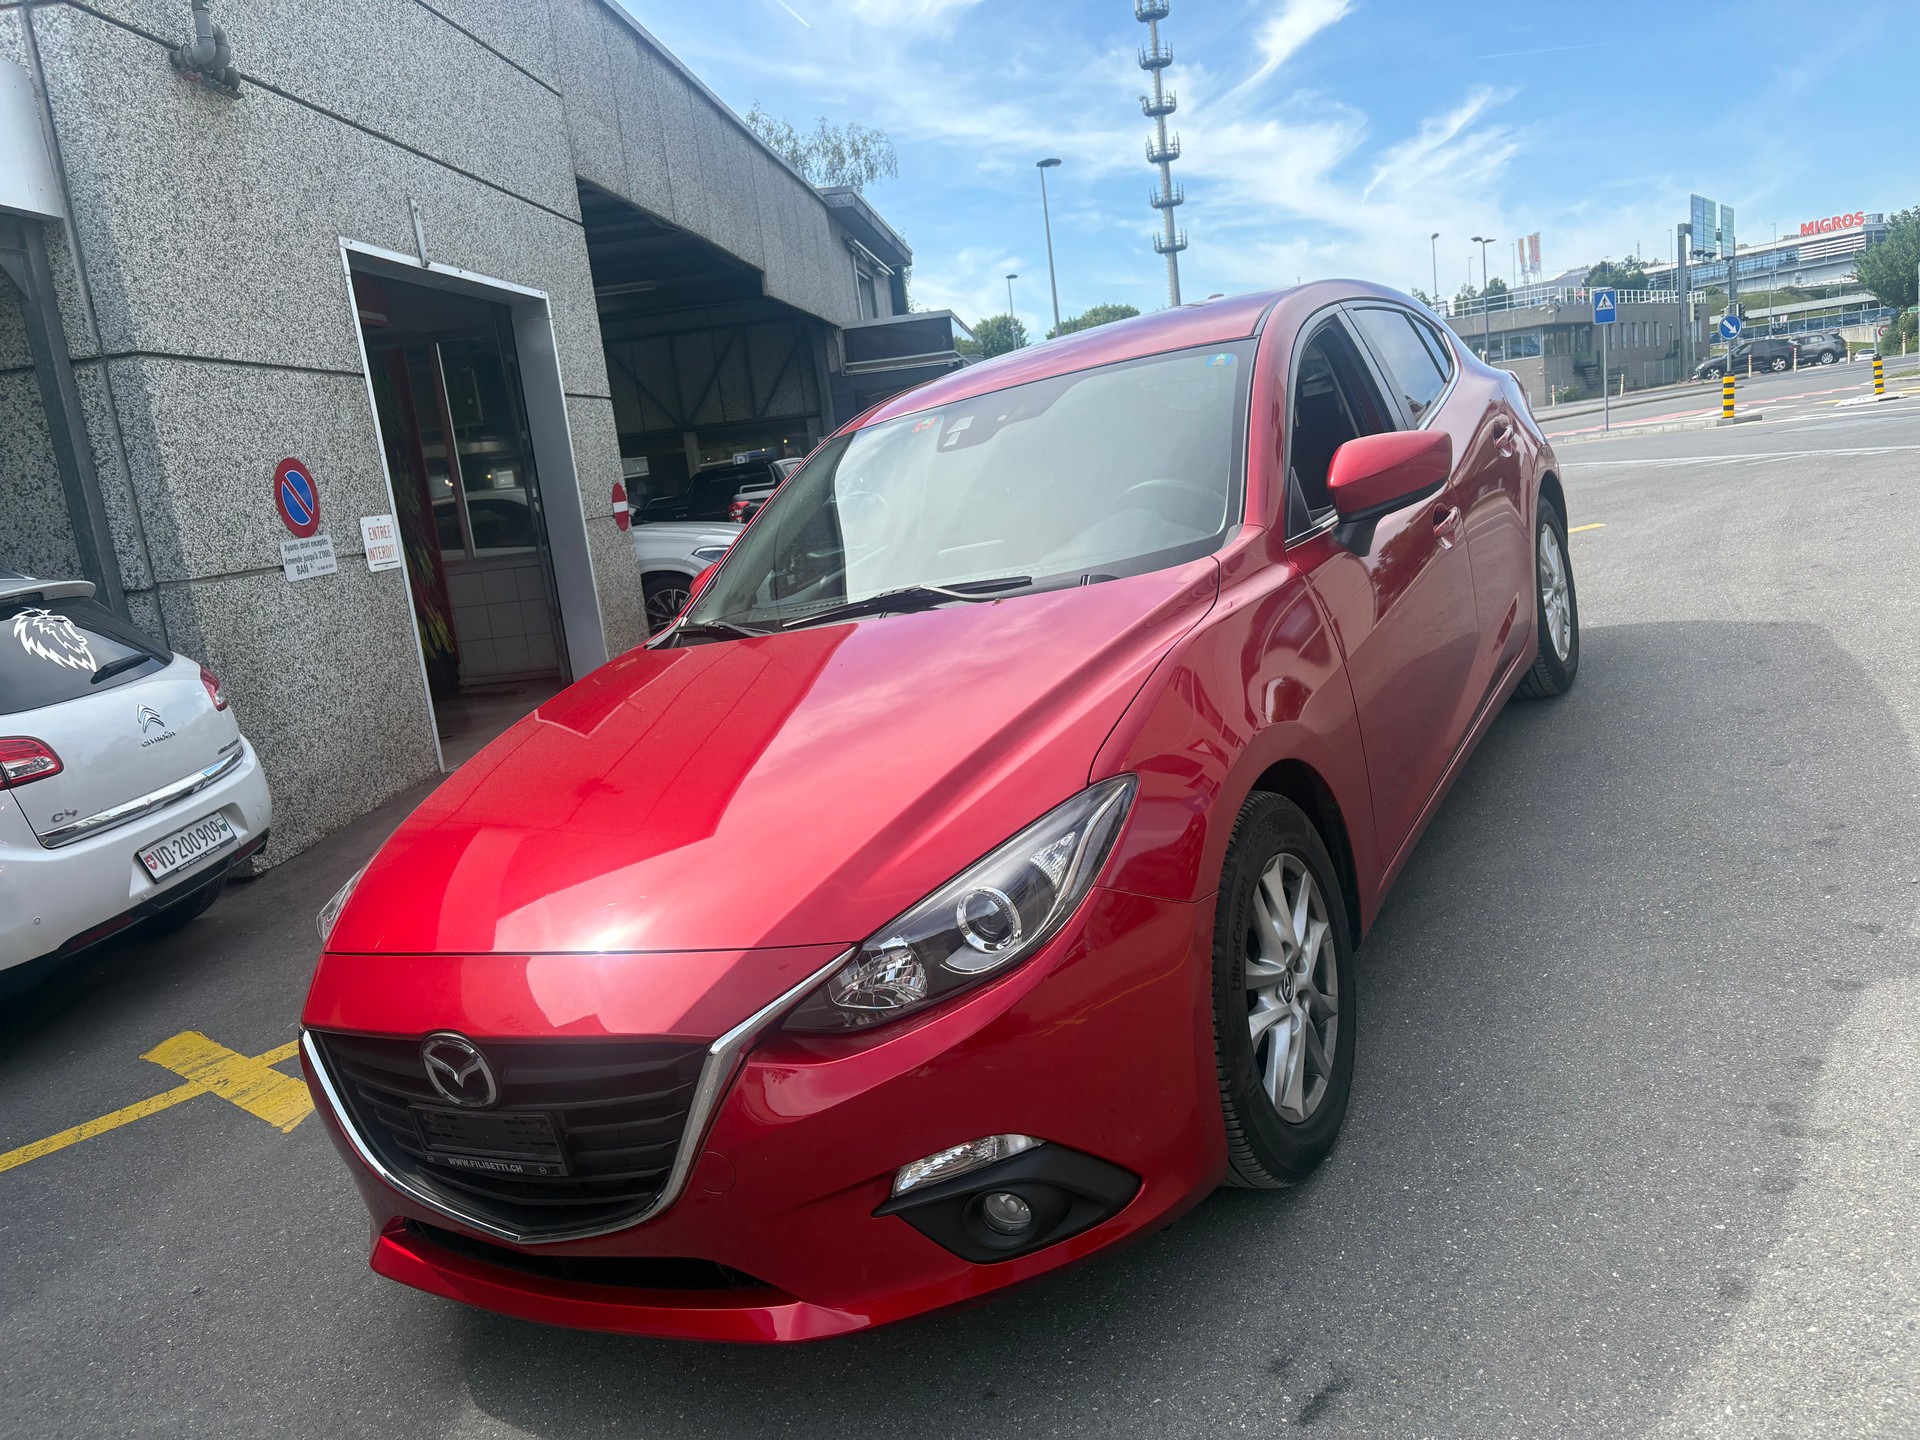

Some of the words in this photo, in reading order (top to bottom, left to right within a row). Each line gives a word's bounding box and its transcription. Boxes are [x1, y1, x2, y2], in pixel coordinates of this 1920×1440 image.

[1800, 211, 1865, 236] MIGROS
[368, 525, 392, 541] ENTREE
[299, 540, 310, 549] droit
[285, 554, 303, 565] Amende
[368, 545, 397, 561] INTERDIT
[296, 563, 309, 575] BAN
[51, 808, 78, 823] C4
[1231, 875, 1251, 992] UltraContact
[447, 1157, 524, 1173] WWW.FILISETTI.CH
